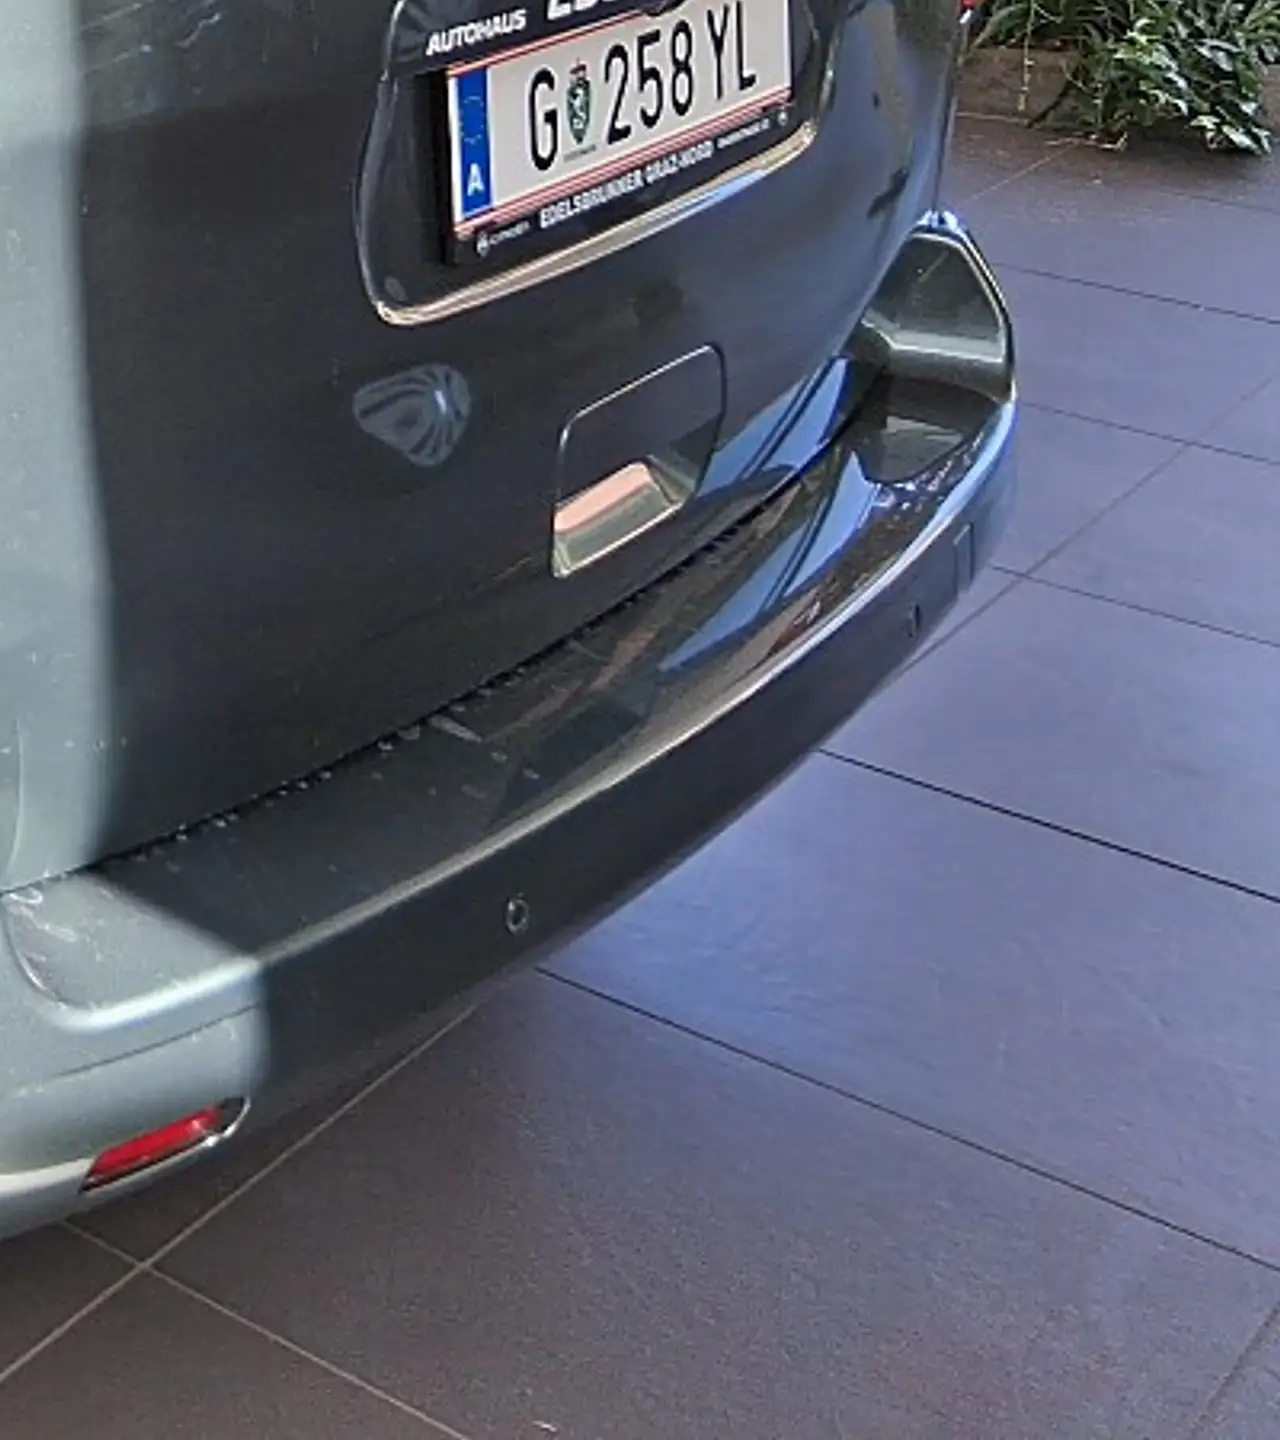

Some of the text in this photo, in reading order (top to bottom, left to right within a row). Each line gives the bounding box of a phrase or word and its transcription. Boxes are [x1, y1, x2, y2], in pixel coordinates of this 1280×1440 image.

[426, 8, 528, 56] AUTOHAUS
[528, 0, 757, 171] G 258 YL
[467, 162, 485, 197] A
[540, 169, 644, 229] EDELSBRUNNER
